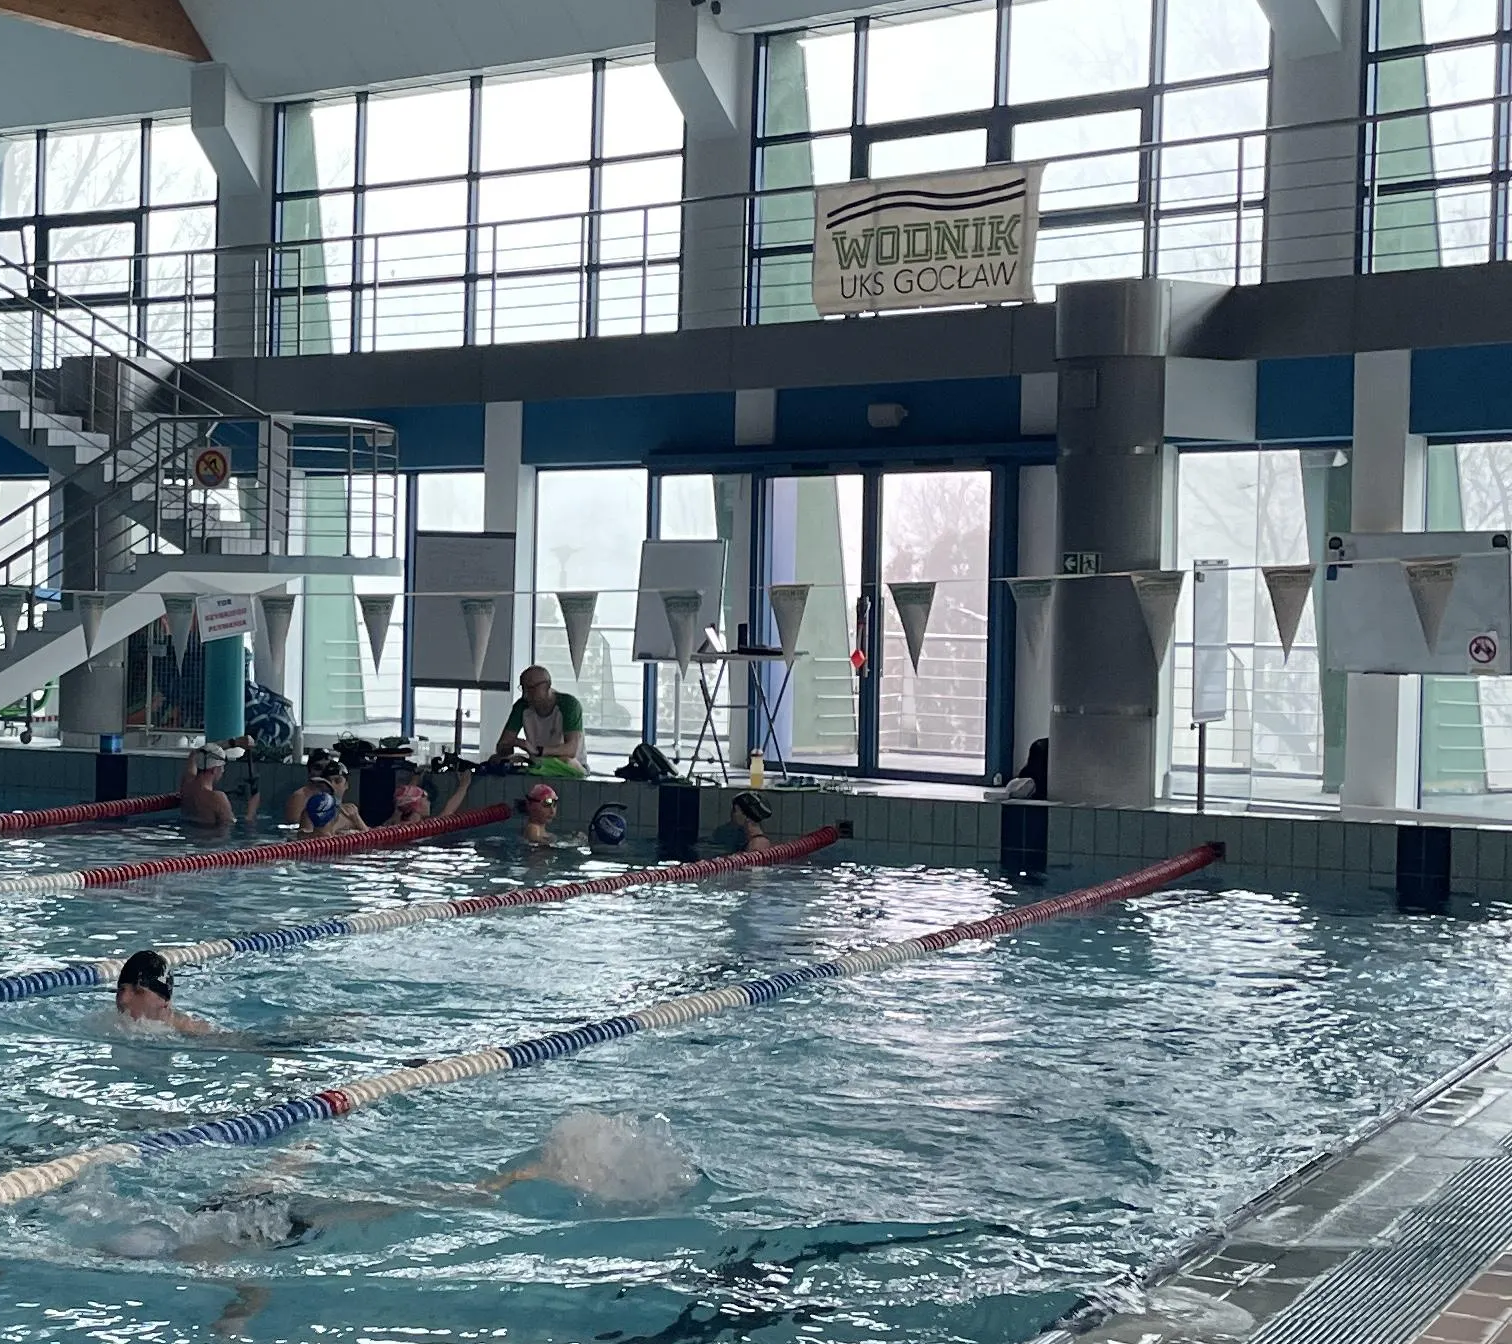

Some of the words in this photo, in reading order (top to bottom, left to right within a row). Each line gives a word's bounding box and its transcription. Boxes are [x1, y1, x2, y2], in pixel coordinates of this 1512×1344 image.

[832, 214, 1022, 270] WODNIK
[840, 271, 885, 300] UKS
[893, 260, 1018, 294] GOCŁAW
